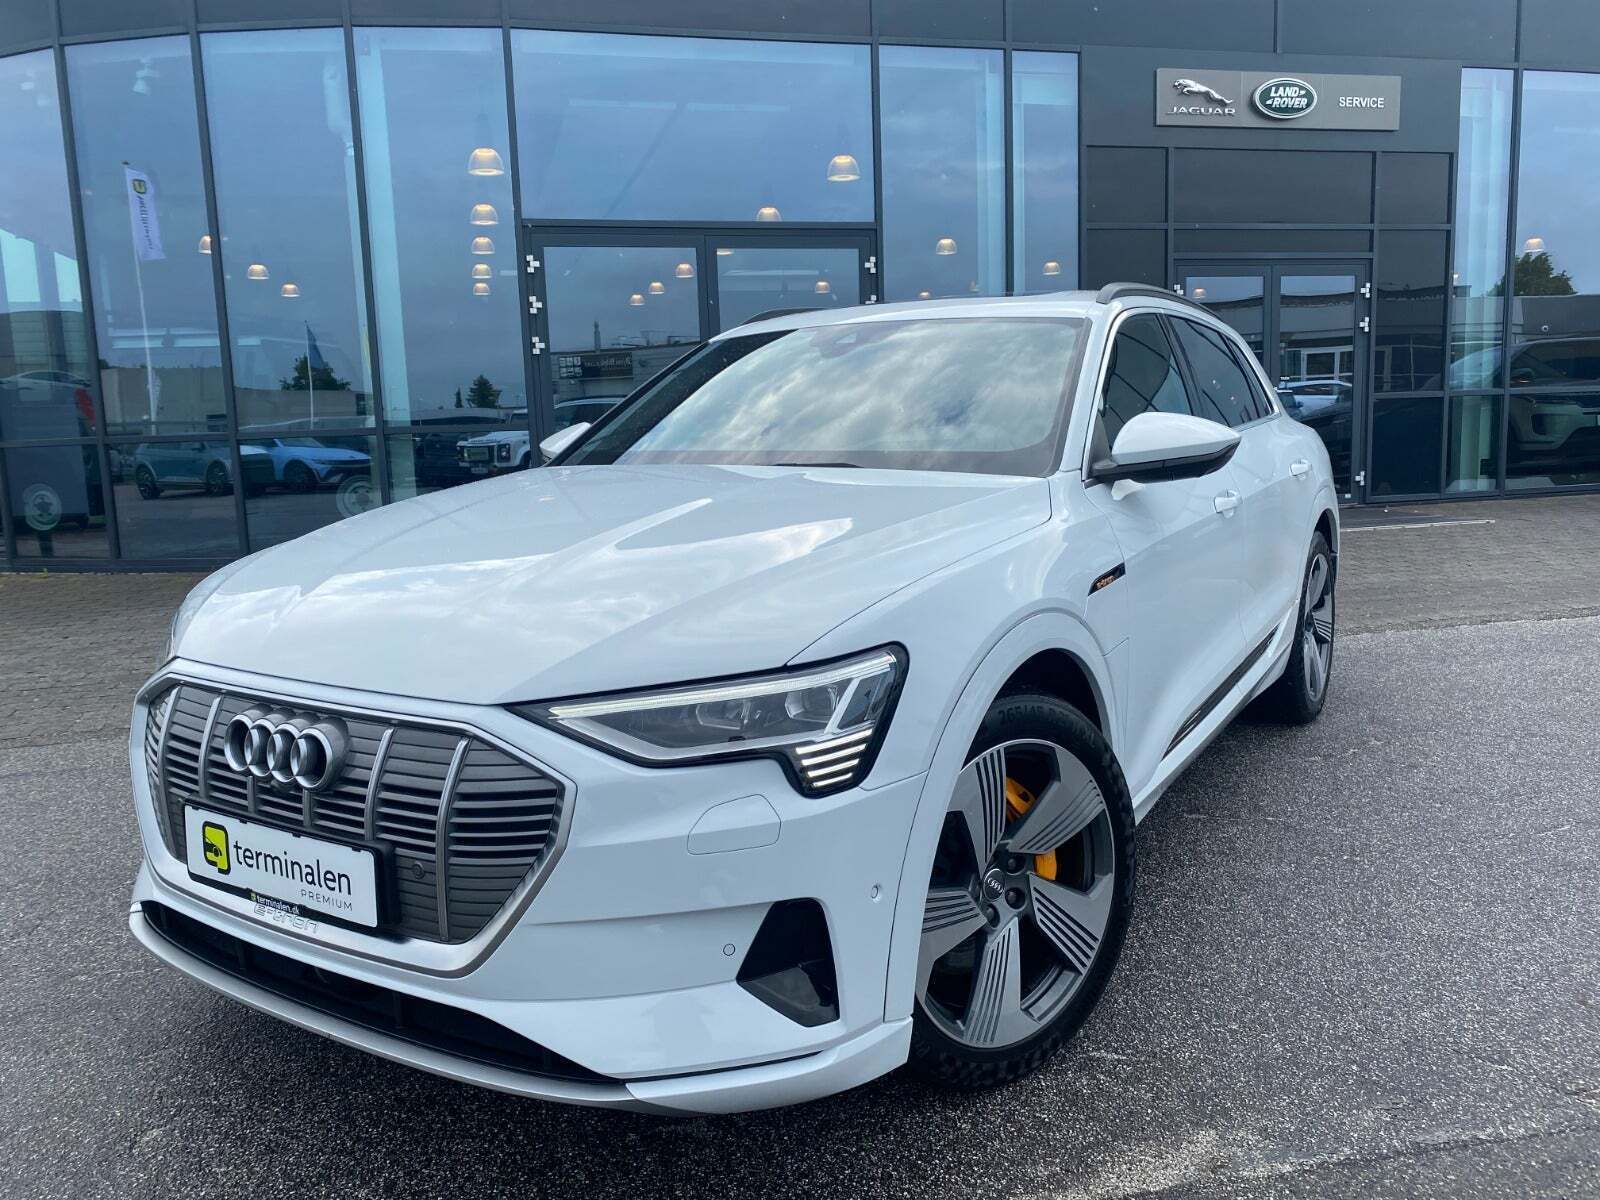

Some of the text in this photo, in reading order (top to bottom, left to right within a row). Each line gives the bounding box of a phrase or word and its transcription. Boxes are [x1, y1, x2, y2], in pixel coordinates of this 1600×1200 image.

[1270, 86, 1300, 97] LAND
[1272, 97, 1308, 109] ROVER
[1339, 97, 1384, 109] SERVICE
[1167, 106, 1236, 117] JAGUAR
[233, 839, 352, 896] terminalen
[256, 894, 301, 915] terminalen.dk
[300, 889, 353, 911] PREMIUM
